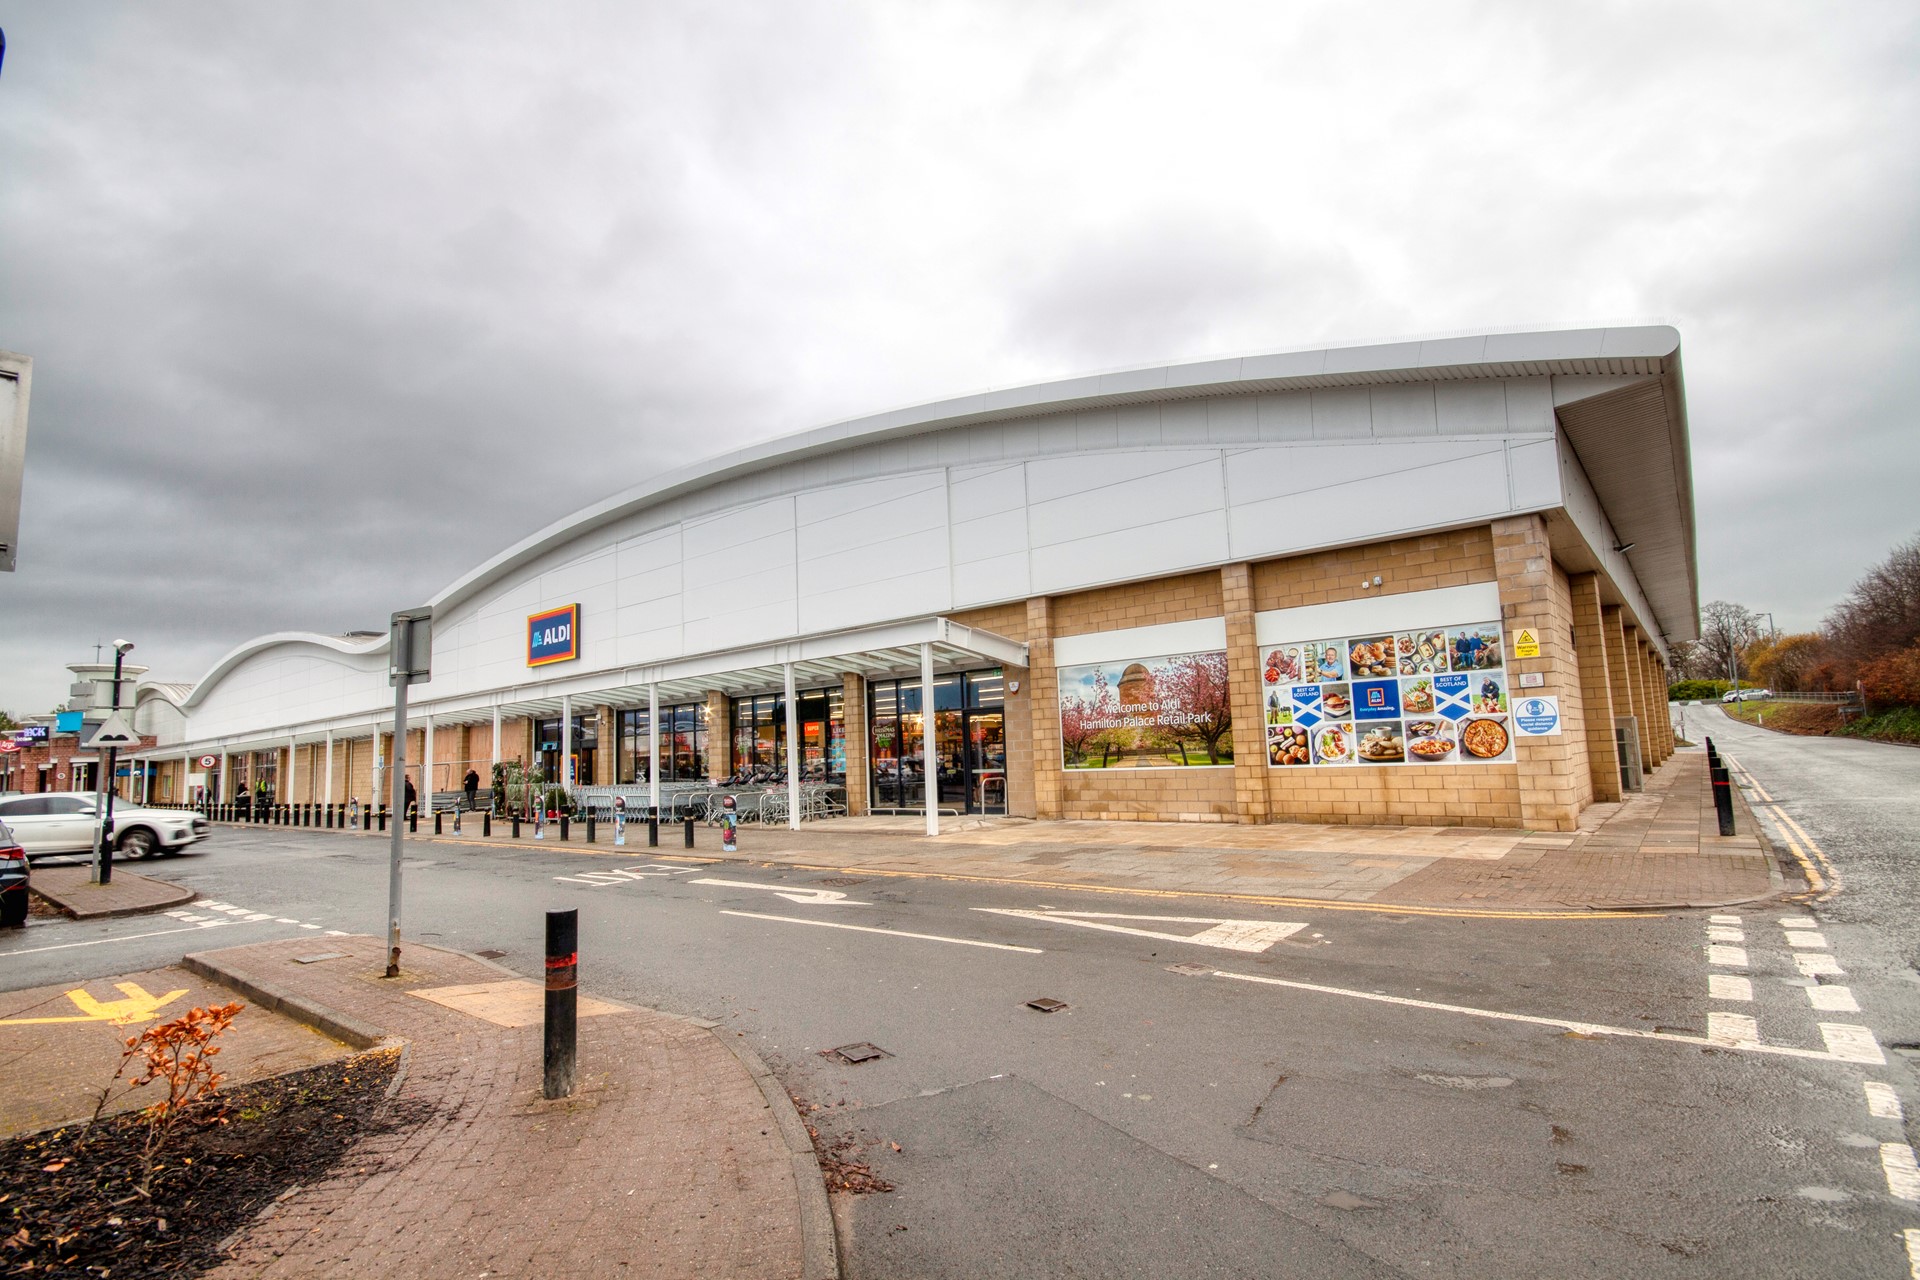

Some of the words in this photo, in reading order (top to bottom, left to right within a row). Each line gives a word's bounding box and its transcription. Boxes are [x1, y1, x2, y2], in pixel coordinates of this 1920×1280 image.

[543, 624, 570, 645] ALDI
[1104, 702, 1147, 714] Welcome
[1150, 702, 1159, 712] to
[1161, 699, 1180, 710] Aldi
[1080, 718, 1122, 730] Hamilton
[1124, 716, 1154, 728] Palace
[1157, 714, 1186, 726] Retail
[1188, 712, 1212, 724] Park
